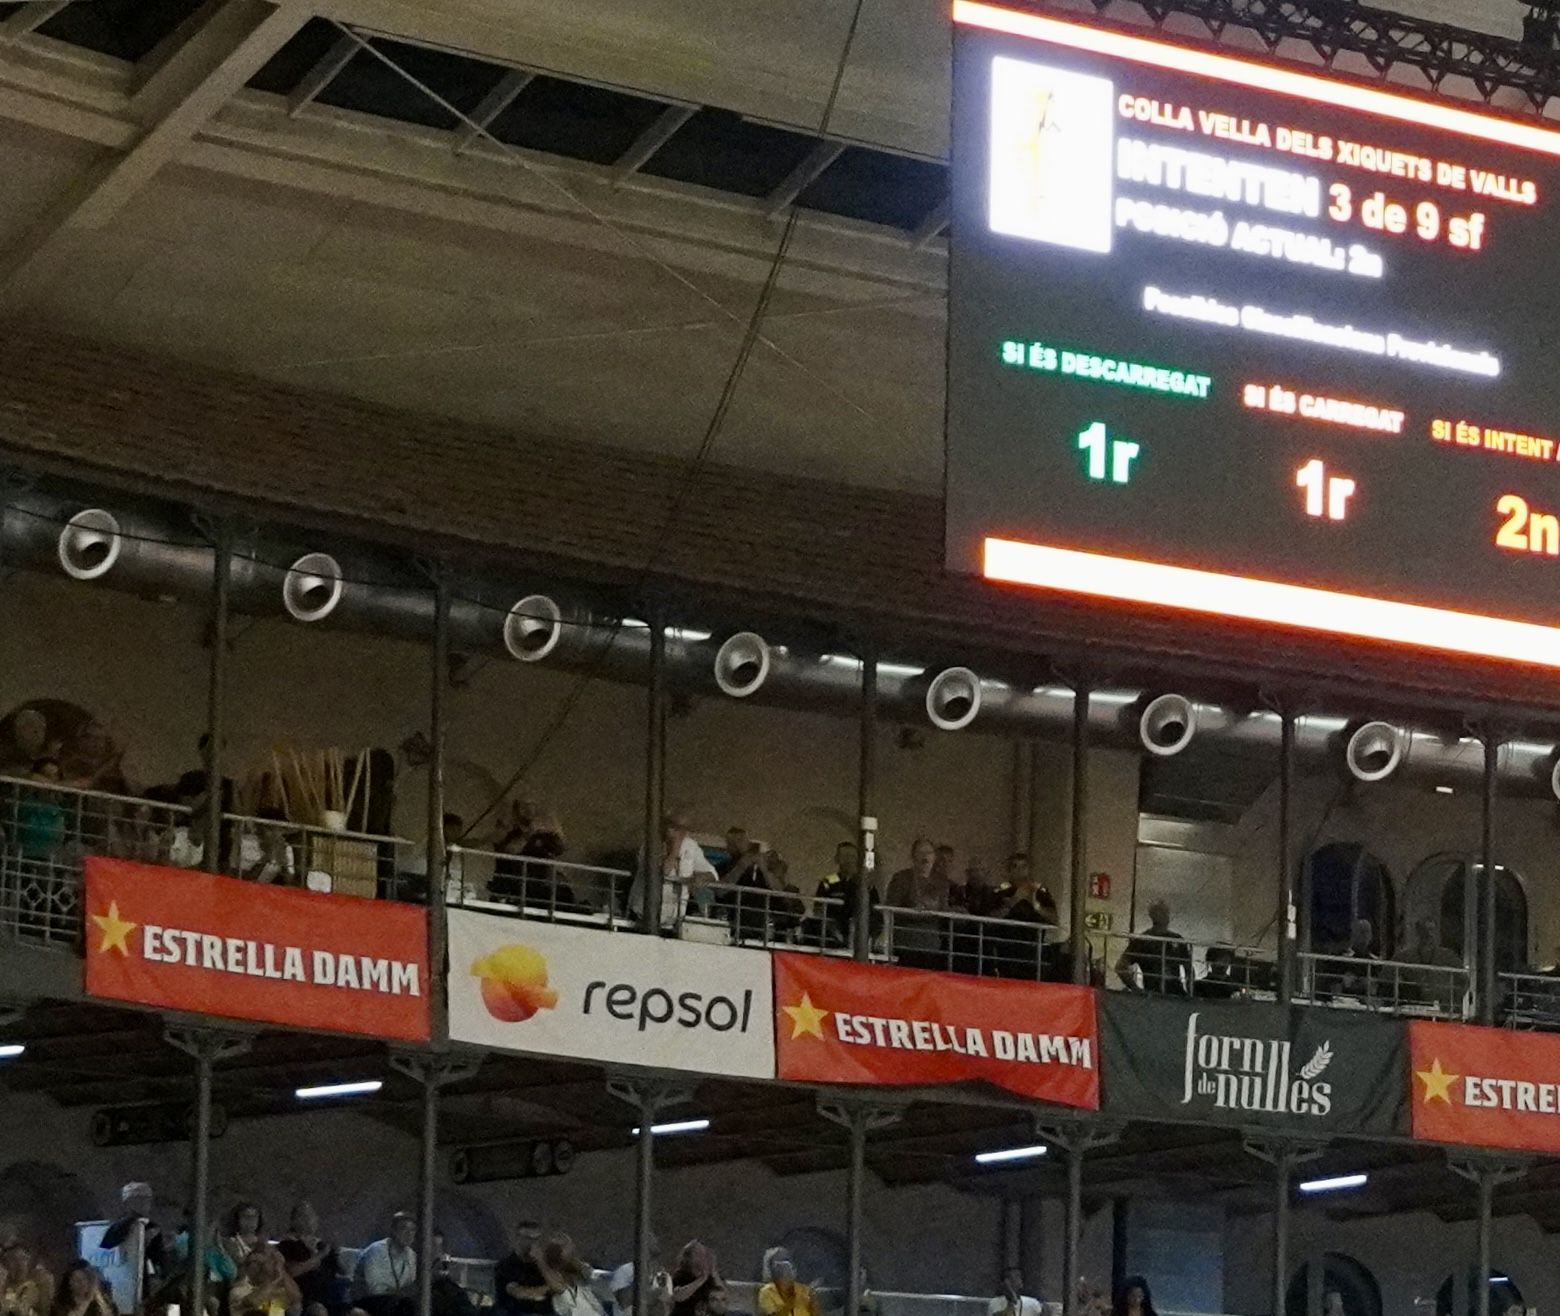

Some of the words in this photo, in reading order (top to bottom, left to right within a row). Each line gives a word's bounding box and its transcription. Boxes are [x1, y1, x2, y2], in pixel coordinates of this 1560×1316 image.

[1118, 94, 1195, 131] COLLA
[1200, 110, 1271, 148] VELLA
[1276, 127, 1333, 161] DELS
[1338, 140, 1432, 182] XIQUETS
[1437, 162, 1466, 190] DE
[1470, 170, 1537, 206] VALLS
[1329, 183, 1352, 222] 3
[1361, 192, 1407, 233] de
[1417, 201, 1440, 241] 9
[1448, 213, 1486, 250] sf
[1002, 341, 1025, 364] SI
[1030, 342, 1058, 370] ÉS
[1062, 352, 1211, 398] DESCARREGAT
[1244, 385, 1266, 408] SI
[1299, 395, 1404, 433] CARREGAT
[1078, 422, 1139, 482] 1r
[1432, 420, 1452, 440] SI
[1455, 420, 1481, 446] ÉS
[1484, 430, 1554, 460] INTENT
[1296, 460, 1356, 520] 1r
[1496, 496, 1560, 555] 2n
[143, 924, 305, 982] ESTRELLA
[312, 950, 420, 997] DAMM
[582, 978, 753, 1034] repsol
[833, 1011, 987, 1058] ESTRELLA
[993, 1030, 1092, 1069] DAMM
